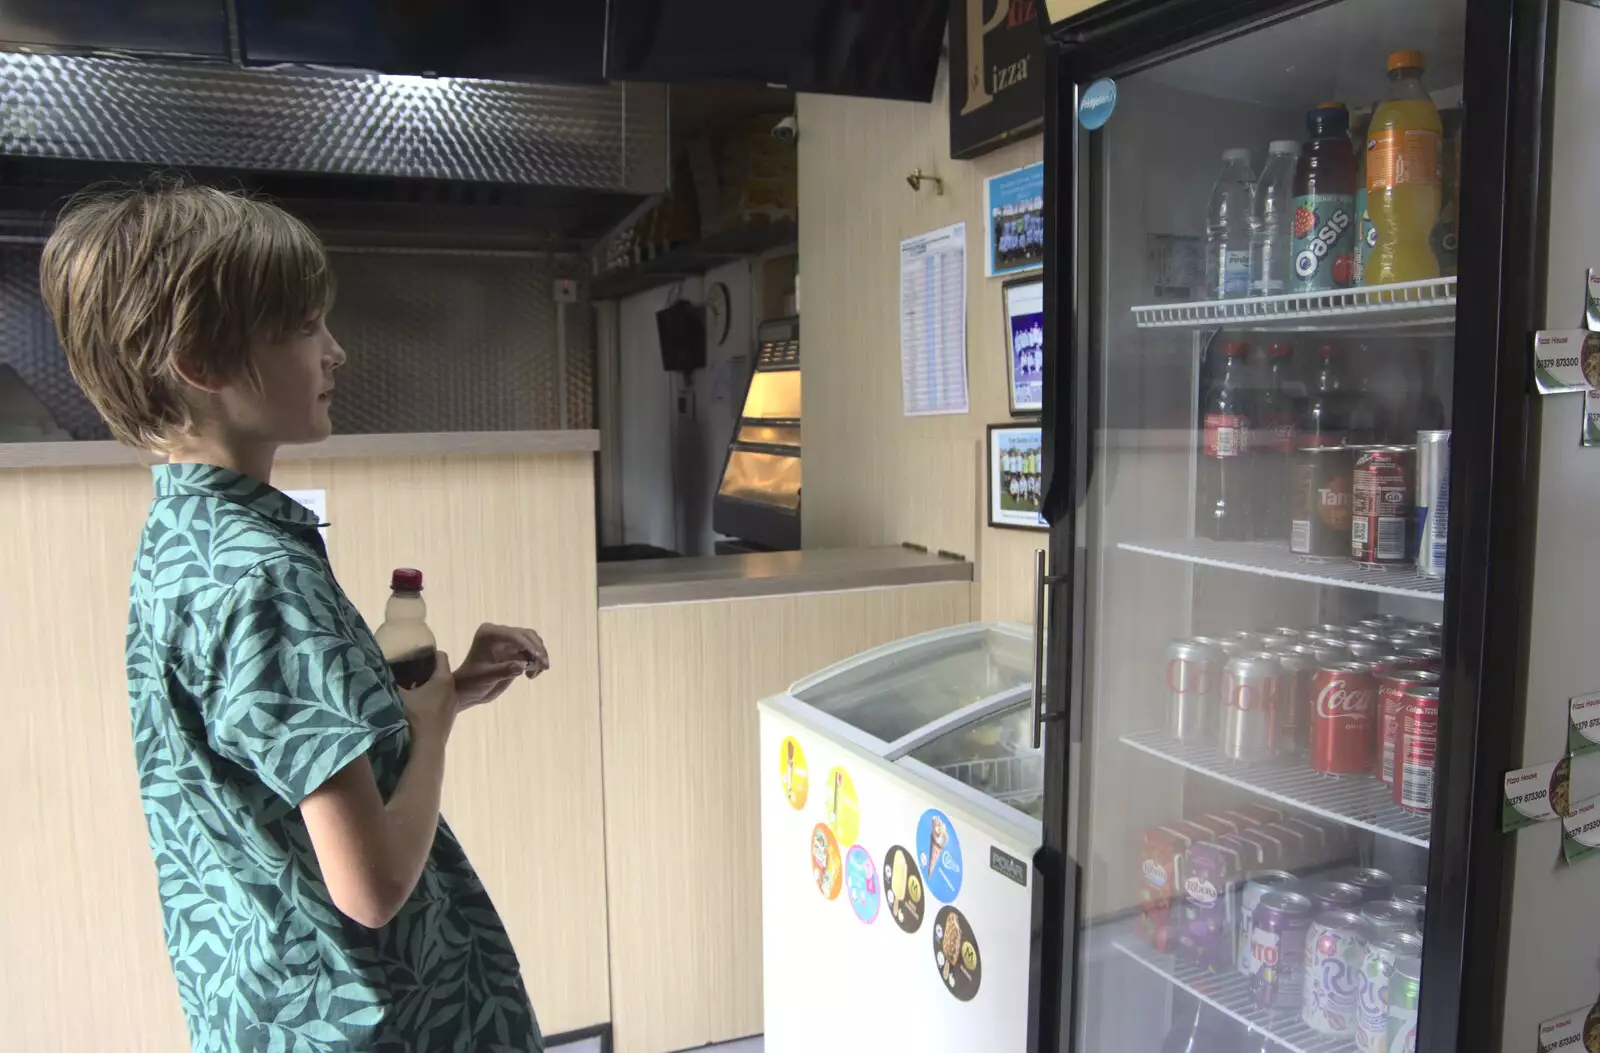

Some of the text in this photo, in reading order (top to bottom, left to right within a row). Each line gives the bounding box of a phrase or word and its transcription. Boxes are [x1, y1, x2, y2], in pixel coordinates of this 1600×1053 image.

[1556, 357, 1579, 368] 873300
[1507, 773, 1538, 786] Pizza House
[1524, 789, 1547, 803] 873300
